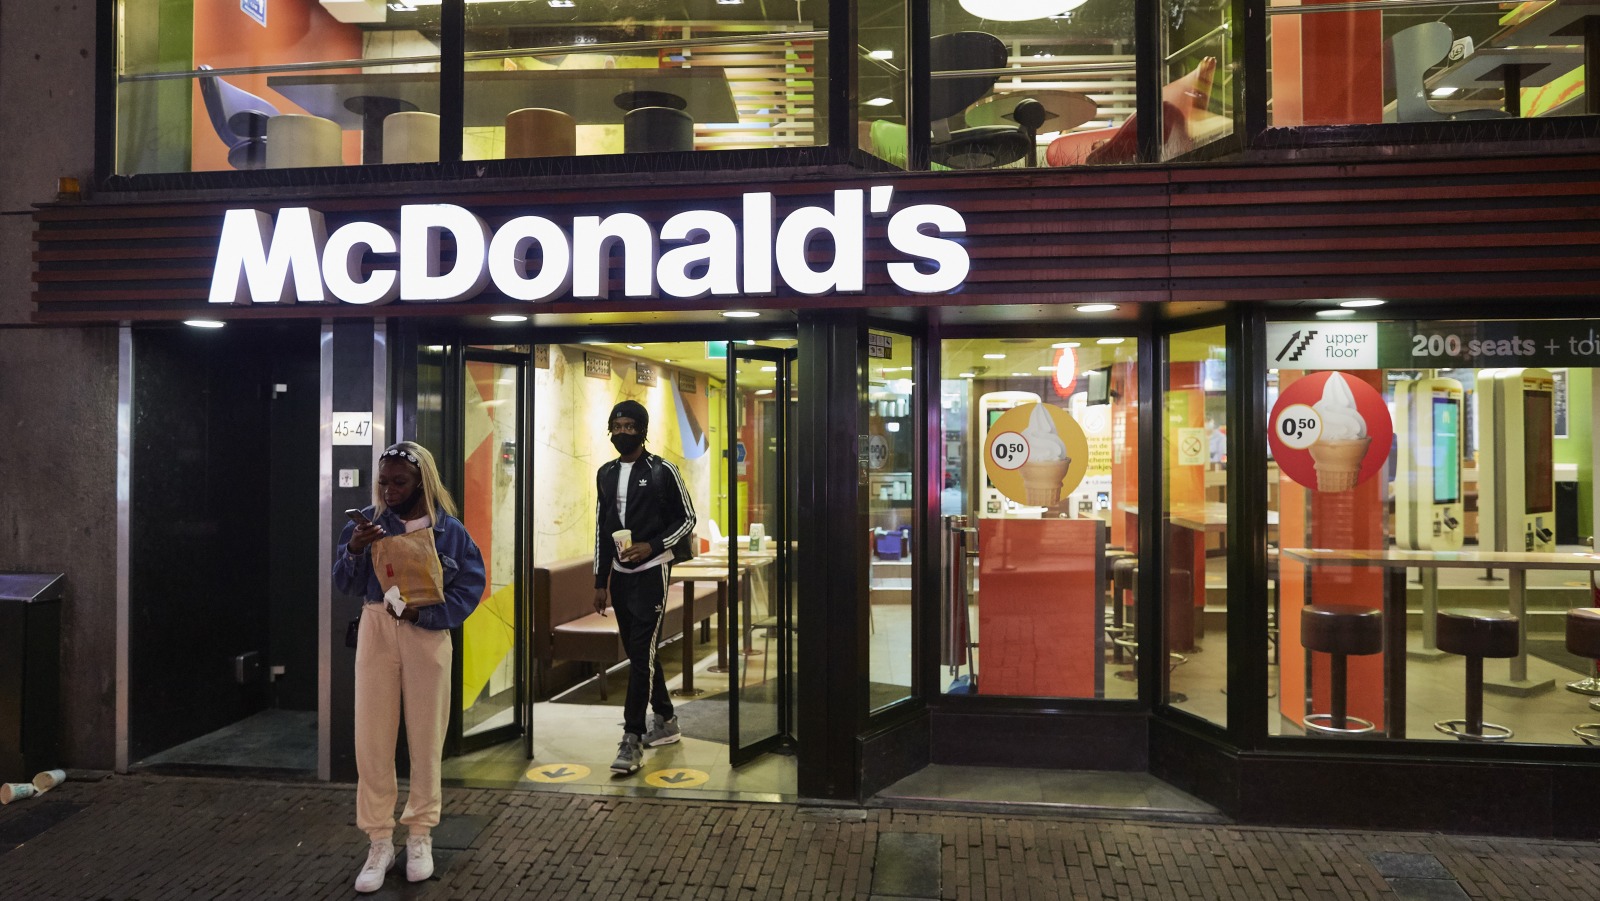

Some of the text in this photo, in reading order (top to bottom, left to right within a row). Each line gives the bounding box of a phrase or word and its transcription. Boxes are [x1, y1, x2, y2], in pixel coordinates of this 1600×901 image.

[208, 185, 970, 304] McDonald's
[1325, 334, 1368, 346] upper
[1411, 334, 1462, 356] 200
[1468, 335, 1536, 356] seats
[1325, 345, 1360, 358] floor
[334, 420, 370, 437] 45-47
[1281, 417, 1316, 440] 0,50
[994, 443, 1025, 462] 0,50
